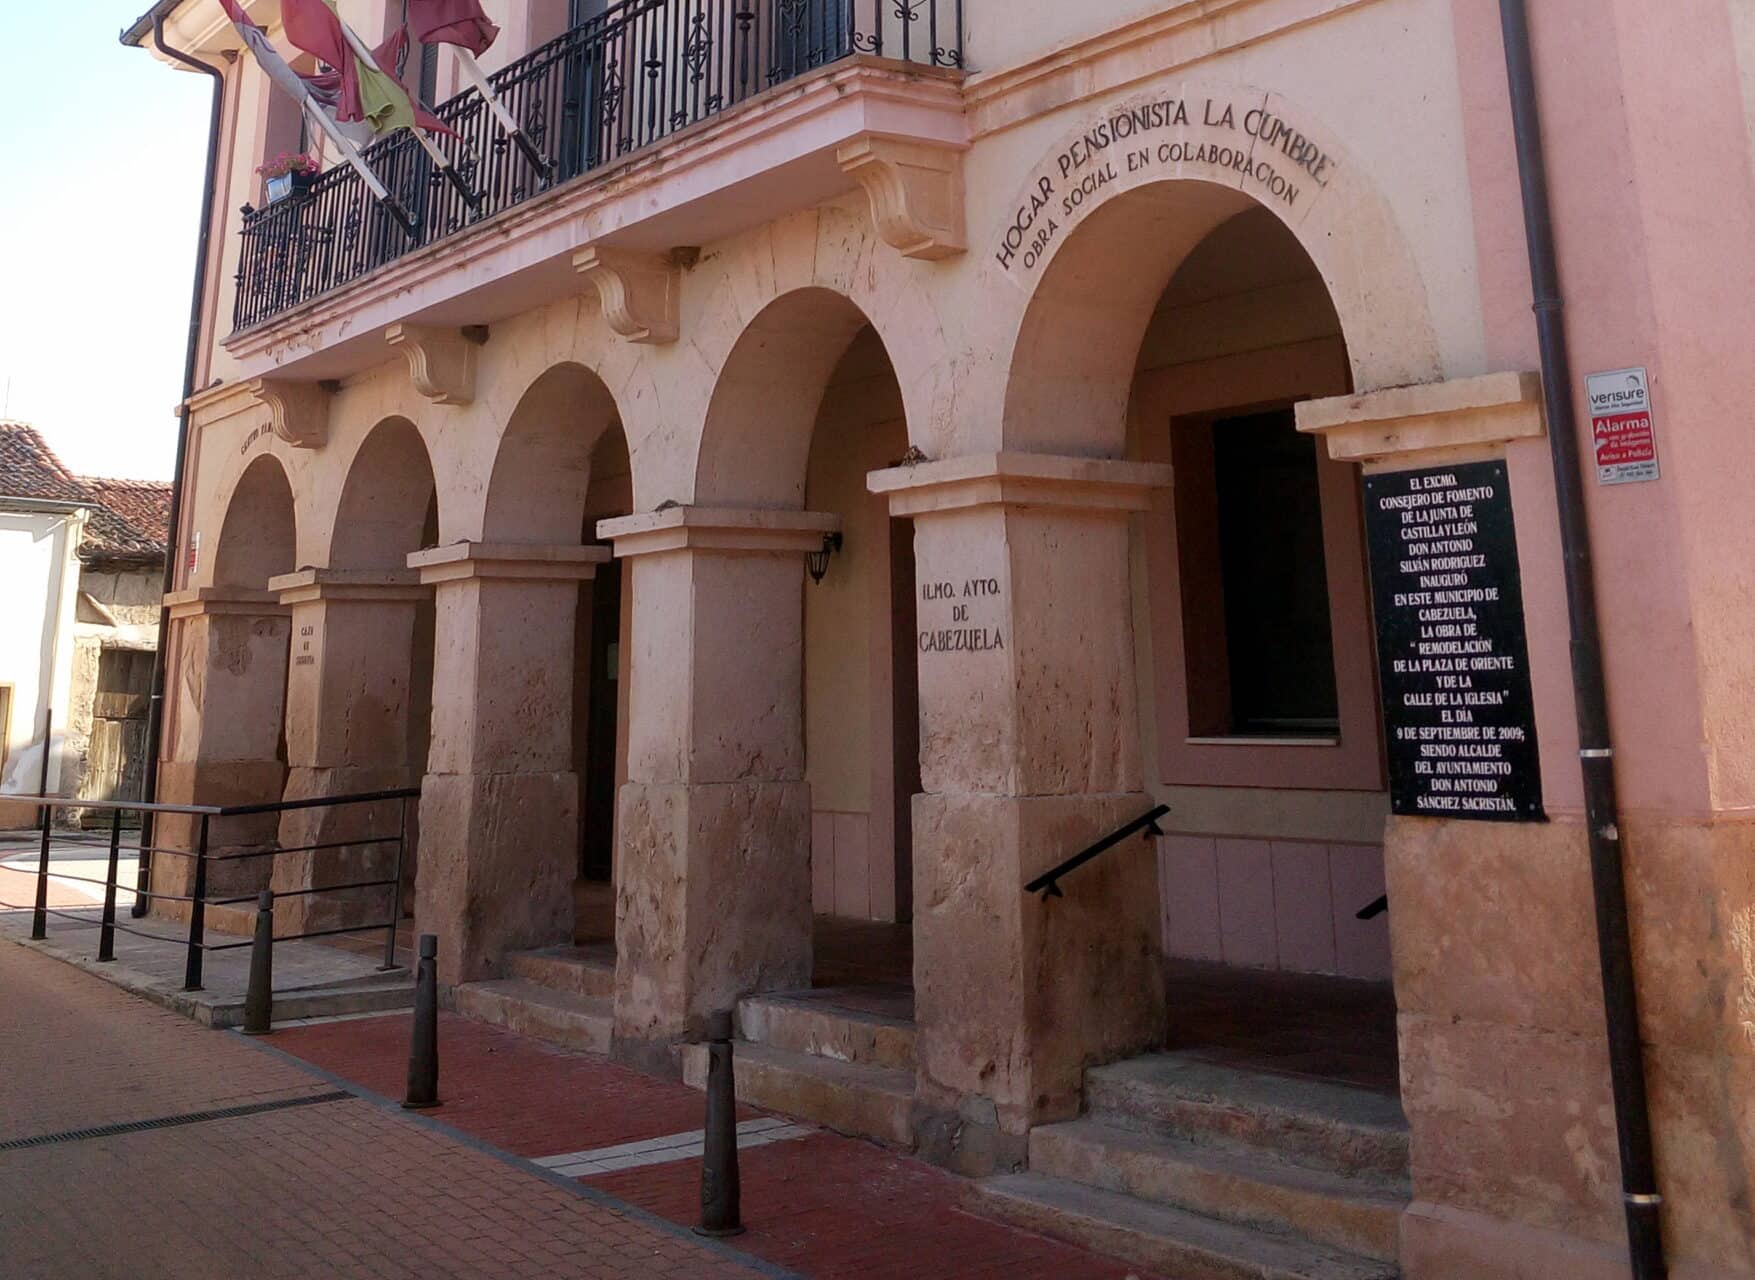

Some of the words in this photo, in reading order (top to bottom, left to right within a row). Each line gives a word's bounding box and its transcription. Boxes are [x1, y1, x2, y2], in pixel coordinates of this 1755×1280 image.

[996, 176, 1055, 270] HOGAR
[1057, 99, 1188, 180] PENSIONISTA
[1204, 99, 1236, 130] LA
[1244, 110, 1334, 187] CUMBRE
[1023, 219, 1059, 269] OBRA
[1063, 162, 1117, 216] SOCIAL
[1127, 148, 1150, 172] EN
[1157, 143, 1299, 206] COLABORACION
[1591, 388, 1644, 404] verisure
[1596, 418, 1649, 434] Alarma
[1410, 478, 1422, 490] EL
[1424, 474, 1457, 488] EXCMO.
[1380, 493, 1430, 510] CONSEJERO
[1432, 492, 1445, 505] DE
[1446, 486, 1494, 502] FOMENTO
[1401, 511, 1414, 524] DE
[1416, 510, 1428, 523] LA
[1428, 507, 1458, 524] JUNTA
[1459, 505, 1473, 518] DE
[1401, 525, 1443, 539] CASTILLA
[1445, 524, 1452, 536] Y
[1452, 519, 1478, 535] LEÓN
[1409, 543, 1429, 556] DON
[1431, 539, 1473, 554] ANTONIO
[1400, 557, 1430, 573] SILVÁN
[1420, 570, 1468, 588] INAUGURÓ
[923, 582, 956, 600] ILMO.
[963, 578, 1001, 597] AYTO.
[1394, 594, 1408, 606] EN
[1408, 592, 1432, 605] ESTE
[1434, 589, 1484, 604] MUNICIPIO
[1485, 588, 1499, 600] DE
[953, 604, 969, 622] DE
[1419, 606, 1477, 621] CABEZUELA,
[1421, 625, 1434, 638] LA
[1435, 624, 1461, 637] OBRA
[1464, 623, 1477, 636] DE
[919, 627, 1004, 653] CABEZUELA
[1418, 636, 1492, 655] REMODELACIÓN
[1394, 660, 1407, 672] DE
[1408, 660, 1420, 672] LA
[1422, 659, 1453, 671] PLAZA
[1455, 658, 1469, 671] DE
[1470, 656, 1514, 670] ORIENTE
[1436, 676, 1443, 688] Y
[1443, 676, 1457, 688] DE
[1459, 675, 1472, 688] LA
[1403, 693, 1433, 706] CALLE
[1435, 693, 1448, 705] DE
[1450, 692, 1462, 705] LA
[1441, 710, 1454, 722] EL
[1456, 706, 1473, 722] DÍA
[1397, 728, 1403, 739] 9
[1404, 727, 1417, 739] DE
[1419, 727, 1480, 740] SEPTIEMBRE
[1482, 727, 1496, 740] DE
[1420, 744, 1456, 757] SIENDO
[1458, 744, 1502, 757] ALCALDE
[1415, 761, 1433, 774] DEL
[1436, 761, 1512, 775] AYUNTAMIENTO
[1431, 778, 1452, 792] DON
[1454, 779, 1497, 792] ANTONIO
[1417, 793, 1460, 809] SÁNCHEZ
[1461, 794, 1517, 811] SACRISTÁN.
